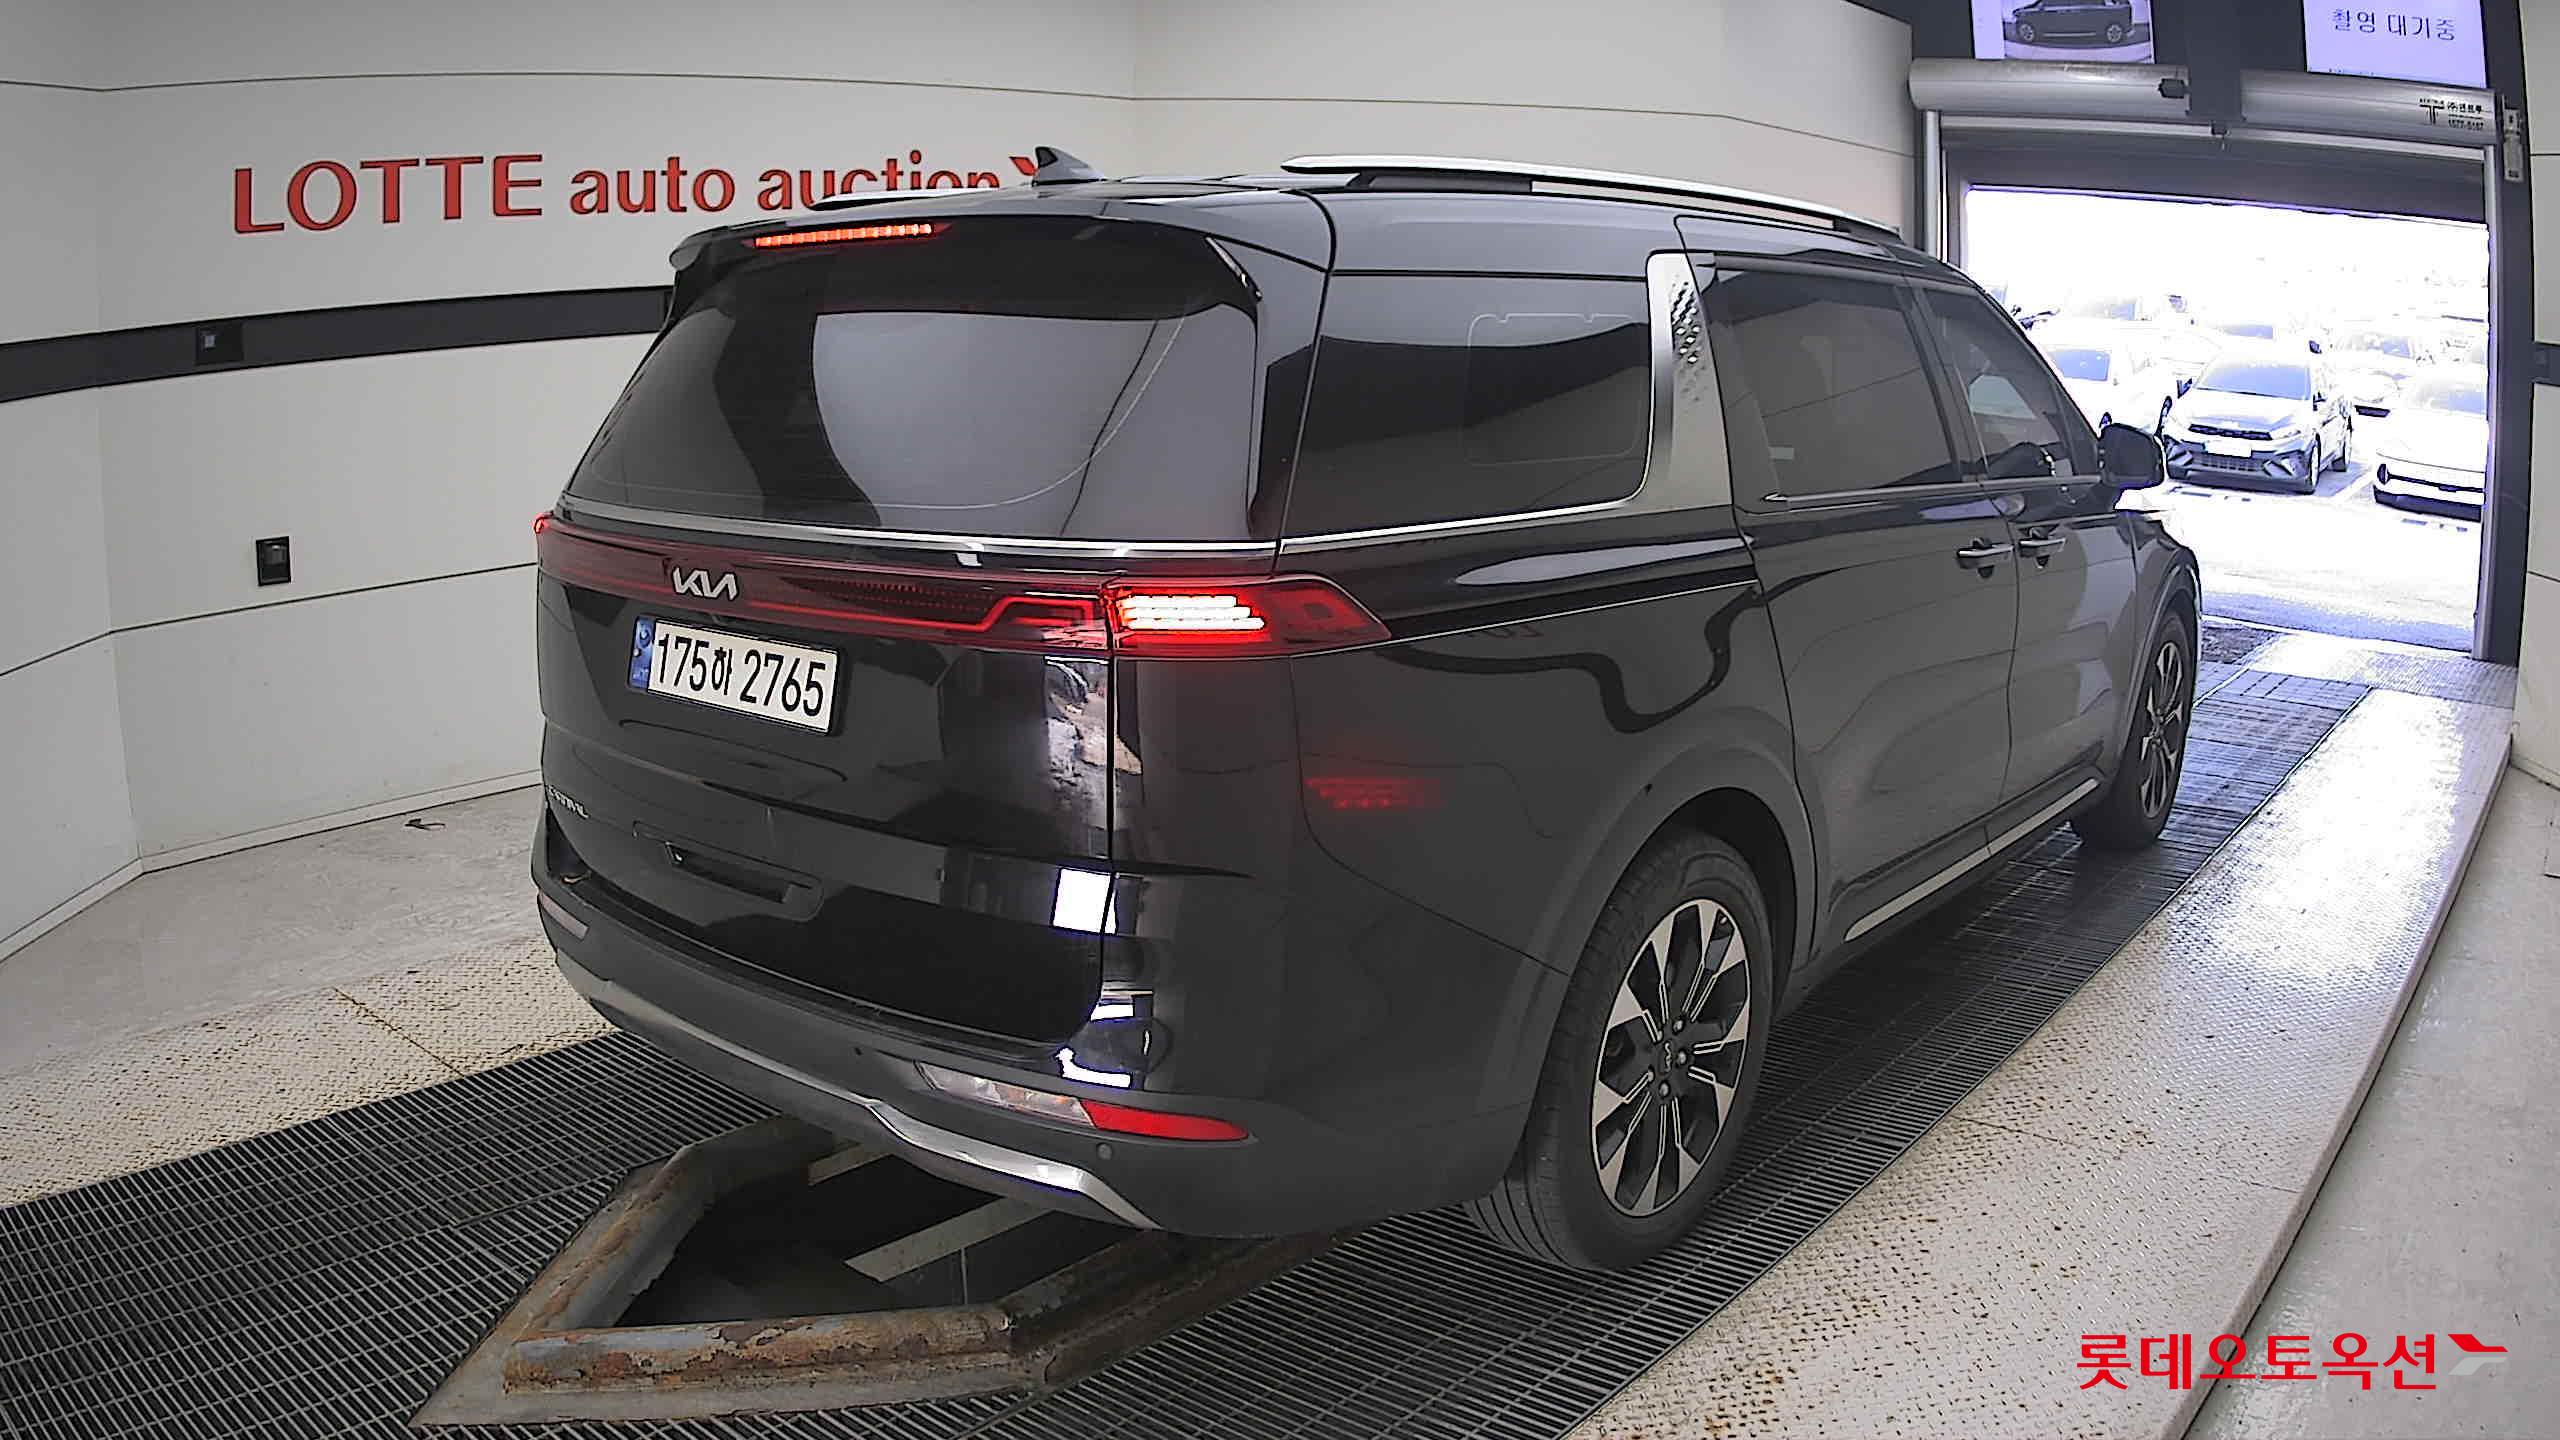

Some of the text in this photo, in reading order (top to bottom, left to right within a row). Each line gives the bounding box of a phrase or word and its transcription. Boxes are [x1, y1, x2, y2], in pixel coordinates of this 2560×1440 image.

[2386, 13, 2456, 41] 대기중
[234, 153, 544, 235] LOTTE
[569, 156, 736, 215] auto
[671, 566, 739, 600] KIA
[658, 632, 825, 717] 175하 2765
